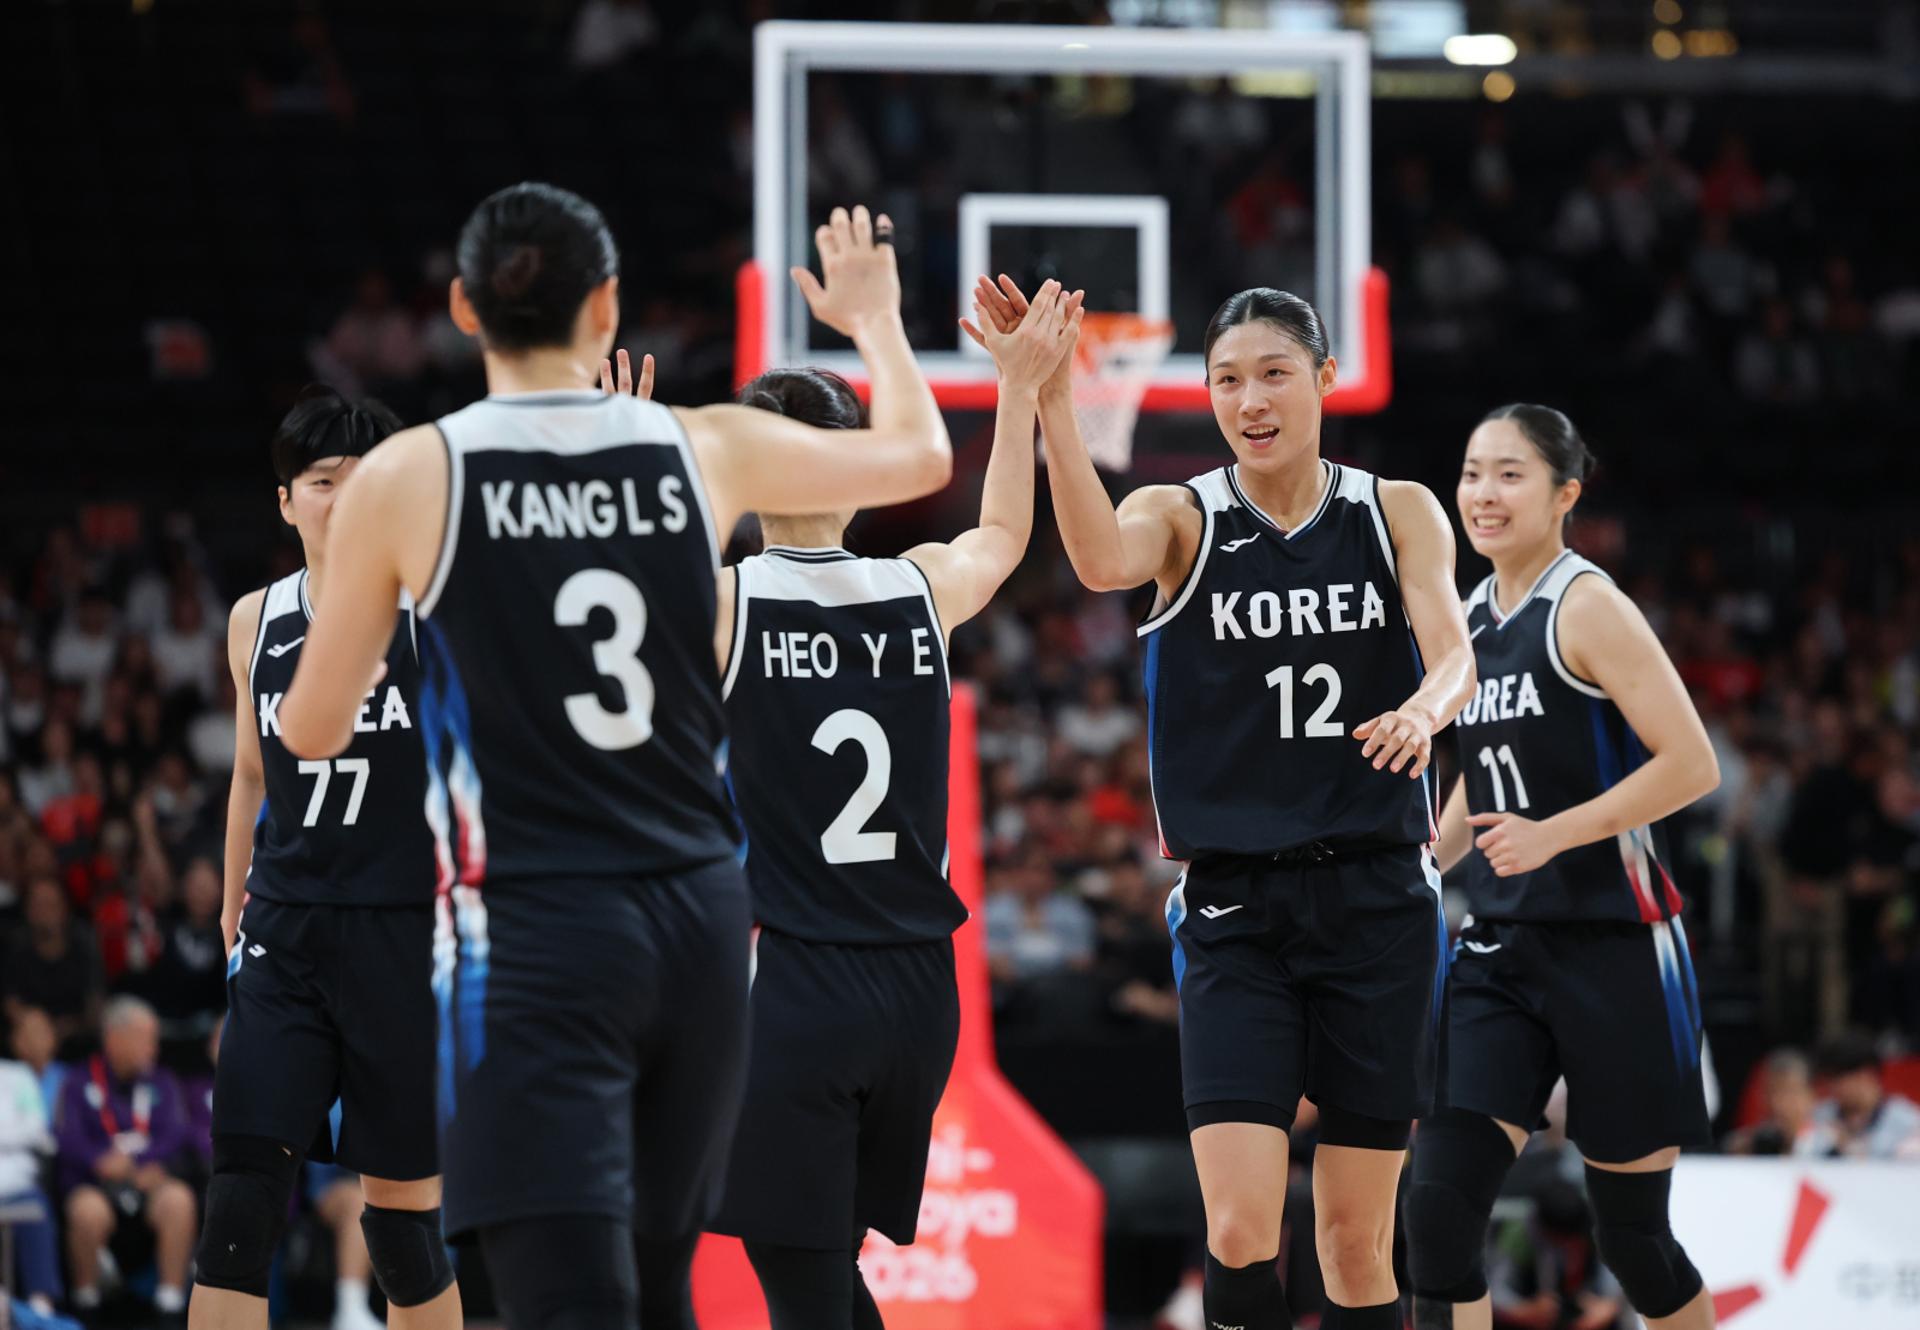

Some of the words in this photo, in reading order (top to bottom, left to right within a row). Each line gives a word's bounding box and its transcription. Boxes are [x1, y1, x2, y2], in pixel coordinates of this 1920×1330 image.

[481, 479, 618, 539] KANG
[1210, 581, 1385, 640] KOREA
[553, 567, 655, 750] 3
[762, 631, 839, 679] HEO
[861, 632, 888, 678] Y
[911, 627, 935, 676] E
[259, 685, 412, 737] KEA
[1265, 662, 1345, 739] 12
[1455, 672, 1545, 727] OREA
[298, 758, 370, 827] 77
[810, 708, 897, 864] 2
[1478, 744, 1530, 812] 11
